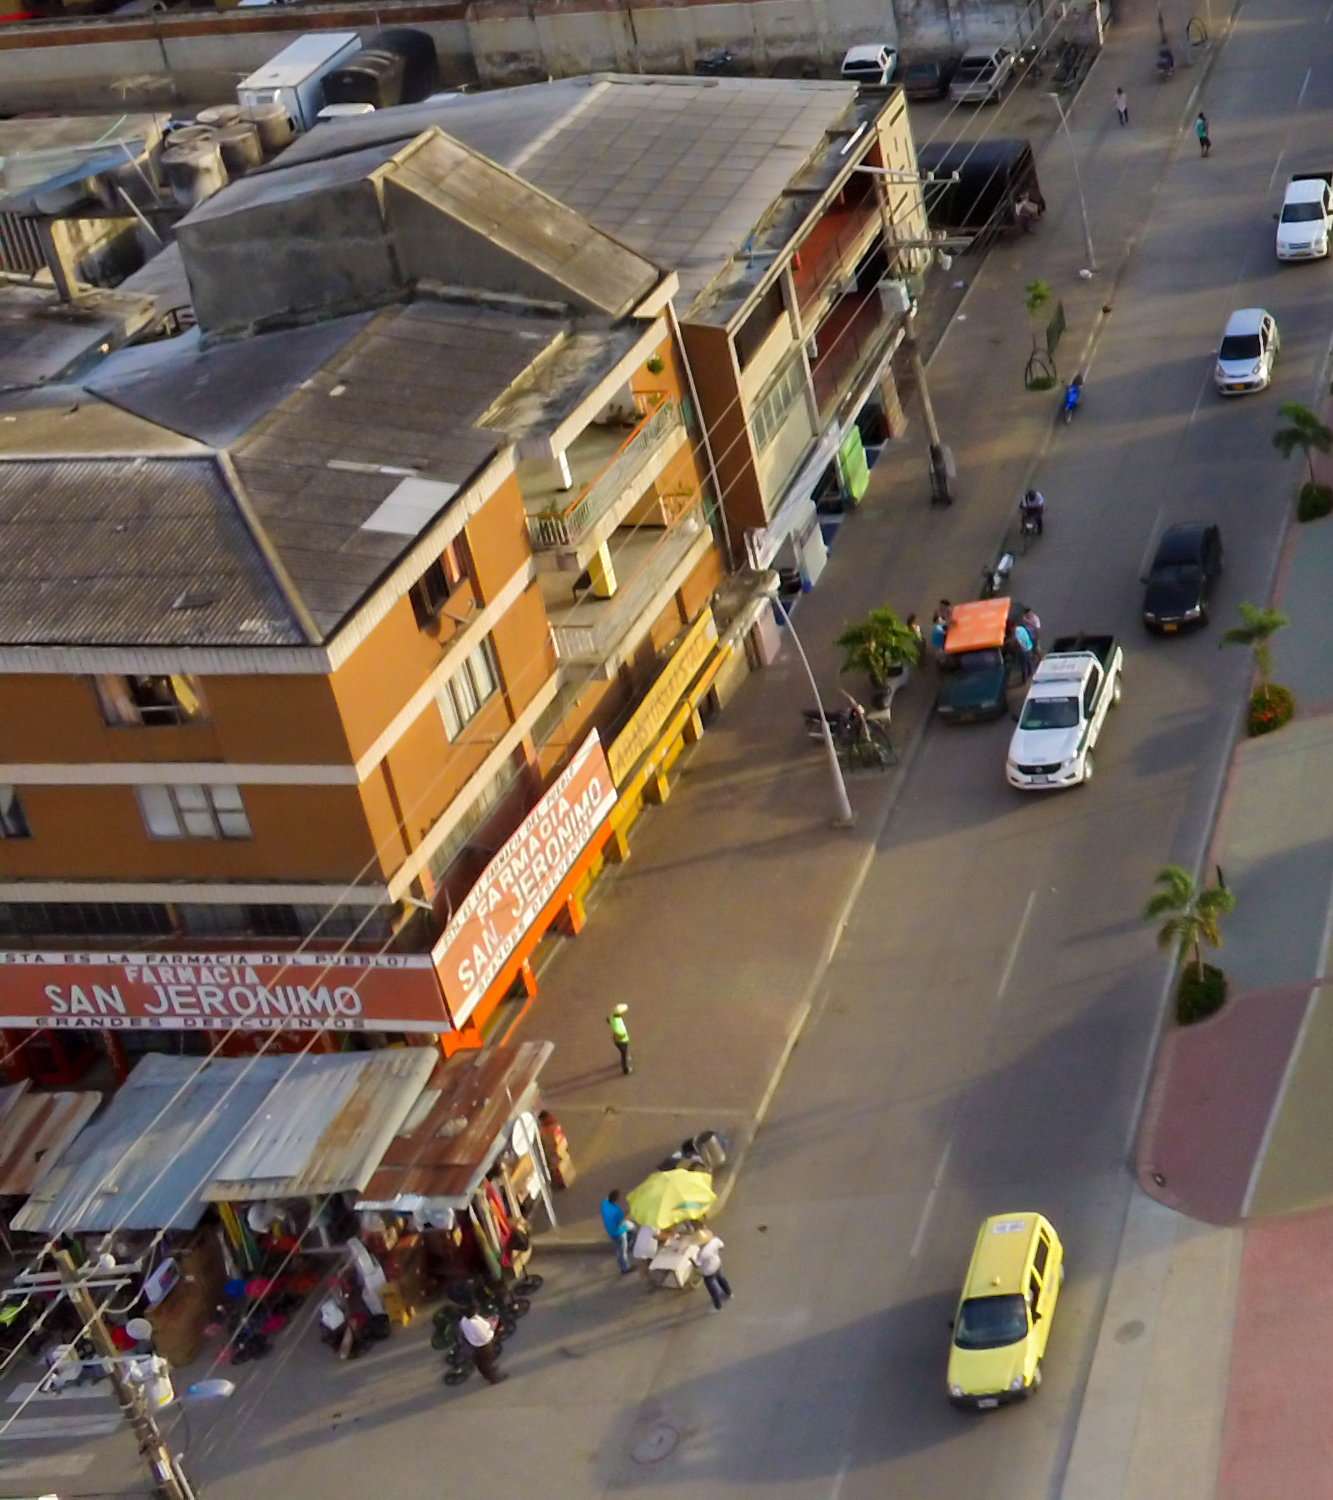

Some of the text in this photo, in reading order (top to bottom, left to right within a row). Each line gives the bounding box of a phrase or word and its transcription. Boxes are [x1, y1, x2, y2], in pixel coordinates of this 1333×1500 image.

[476, 796, 571, 925] FARMACIA
[457, 776, 602, 991] SAN JERONIMO
[4, 953, 46, 964] STA
[64, 954, 91, 964] ES
[106, 954, 131, 964] LA
[145, 954, 249, 966] FARMACIA
[262, 955, 302, 966] DEL
[123, 965, 262, 985] FARMACIA
[44, 984, 363, 1017] SAN JERONIMO
[35, 1017, 365, 1030] GRANDES DESCUENTOS
